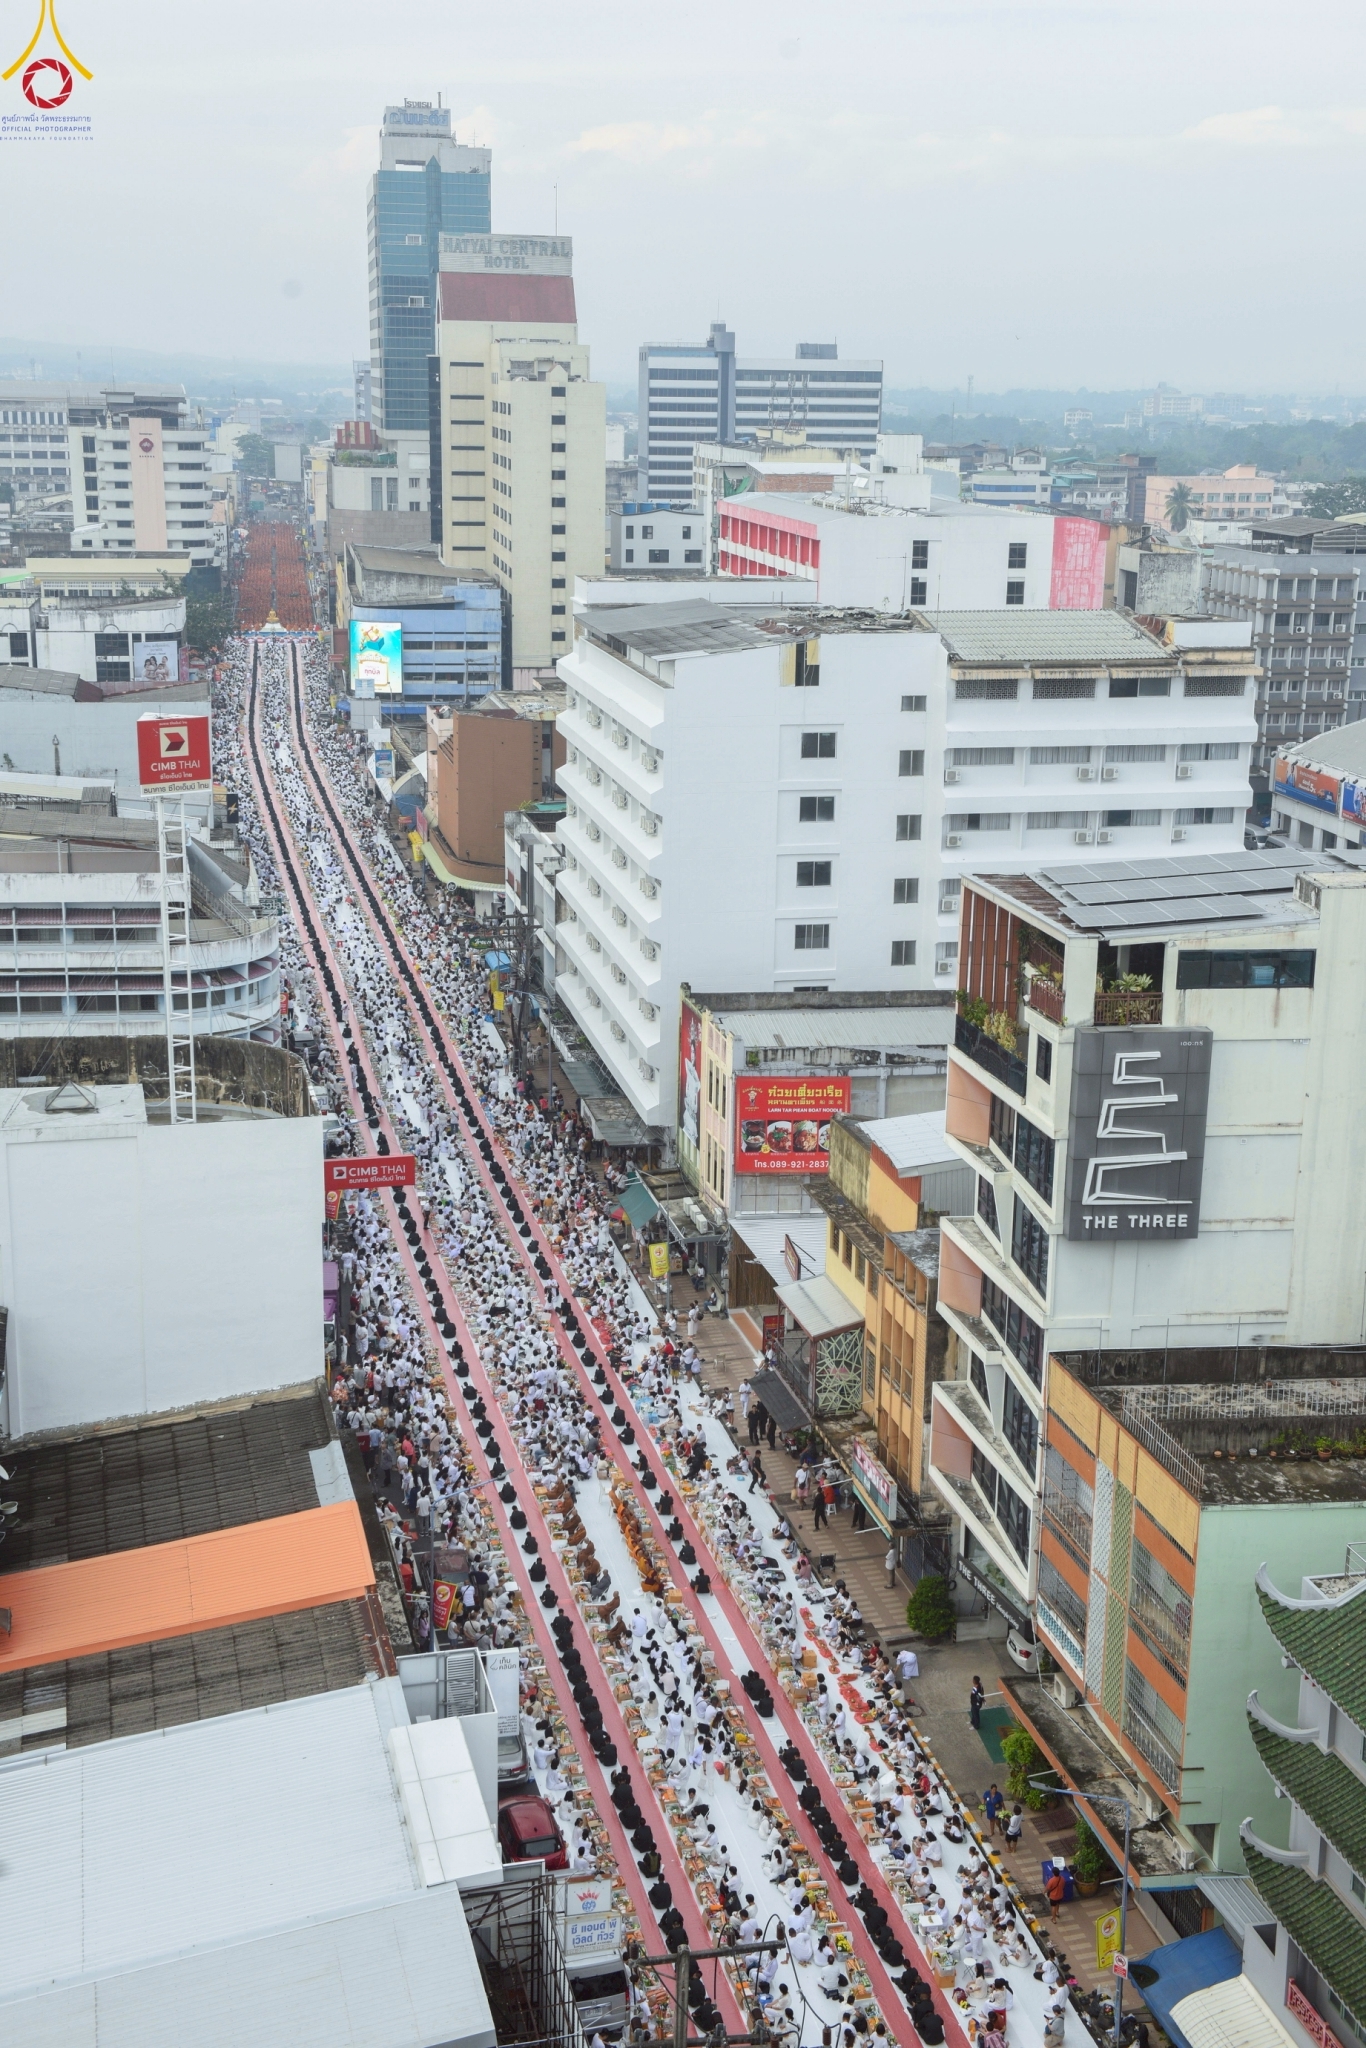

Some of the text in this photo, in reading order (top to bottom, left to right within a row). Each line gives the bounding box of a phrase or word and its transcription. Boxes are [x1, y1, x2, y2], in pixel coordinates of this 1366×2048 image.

[403, 97, 432, 109] โรงแรม
[443, 237, 570, 257] HATYAI CENTRAL
[484, 255, 530, 269] HOTEL
[150, 759, 201, 772] CIMB THAI
[143, 781, 209, 794] ธนาคาร ซีไอเอ็มบี ไทย
[767, 1083, 843, 1097] ก๋วยเตี๋ยวเรือ
[348, 1164, 406, 1177] CIMB THAI
[1082, 1214, 1189, 1229] THE THREE
[958, 1560, 972, 1581] THE
[973, 1576, 996, 1605] THREE
[581, 1919, 607, 1933] แอนด์
[572, 1932, 593, 1945] เวิลด์
[597, 1929, 615, 1941] ทัวร์
